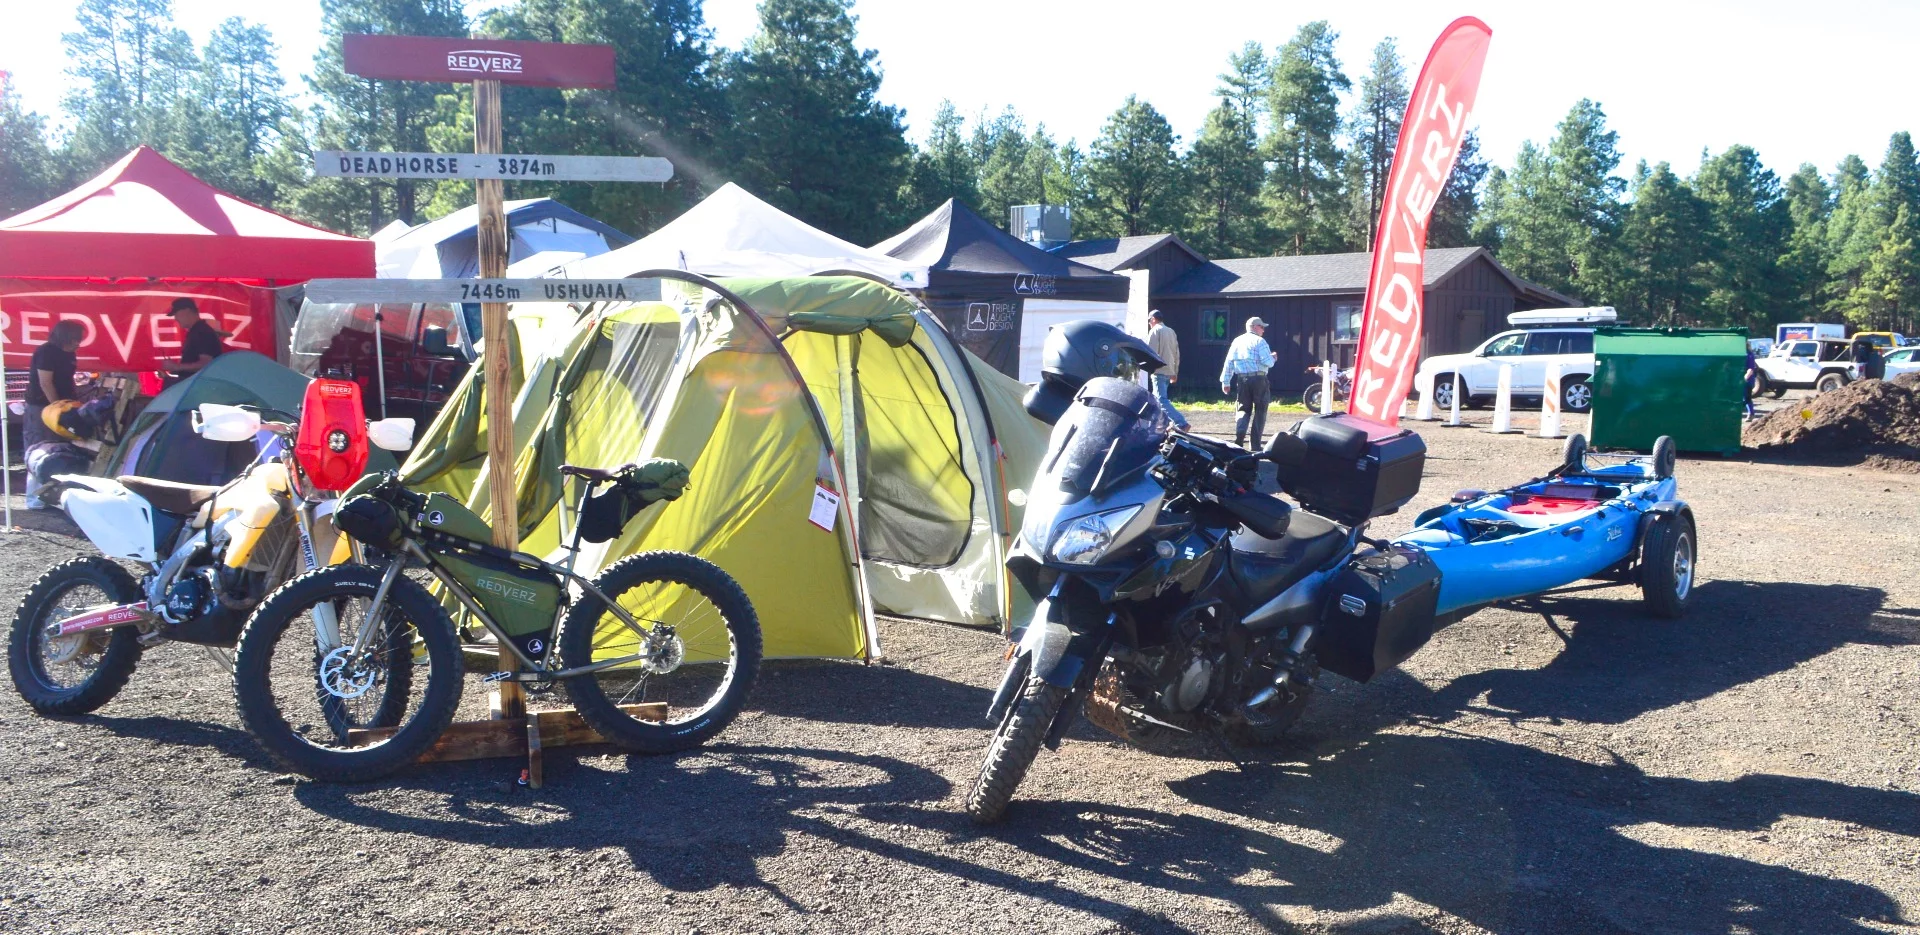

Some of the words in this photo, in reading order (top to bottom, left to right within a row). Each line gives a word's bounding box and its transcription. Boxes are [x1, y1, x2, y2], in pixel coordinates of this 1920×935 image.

[447, 55, 522, 72] REDVERZ
[340, 156, 458, 174] DEADHORSE
[498, 157, 556, 175] 3874m
[1355, 82, 1463, 416] REDVERZ
[461, 284, 520, 300] 7446m
[544, 283, 627, 300] USHUAIA
[991, 303, 1017, 312] TRIPLE
[989, 321, 1014, 331] DESIGN
[0, 310, 253, 363] EDVEZ
[320, 385, 353, 394] REDVERZ
[476, 578, 537, 602] REDVERZ
